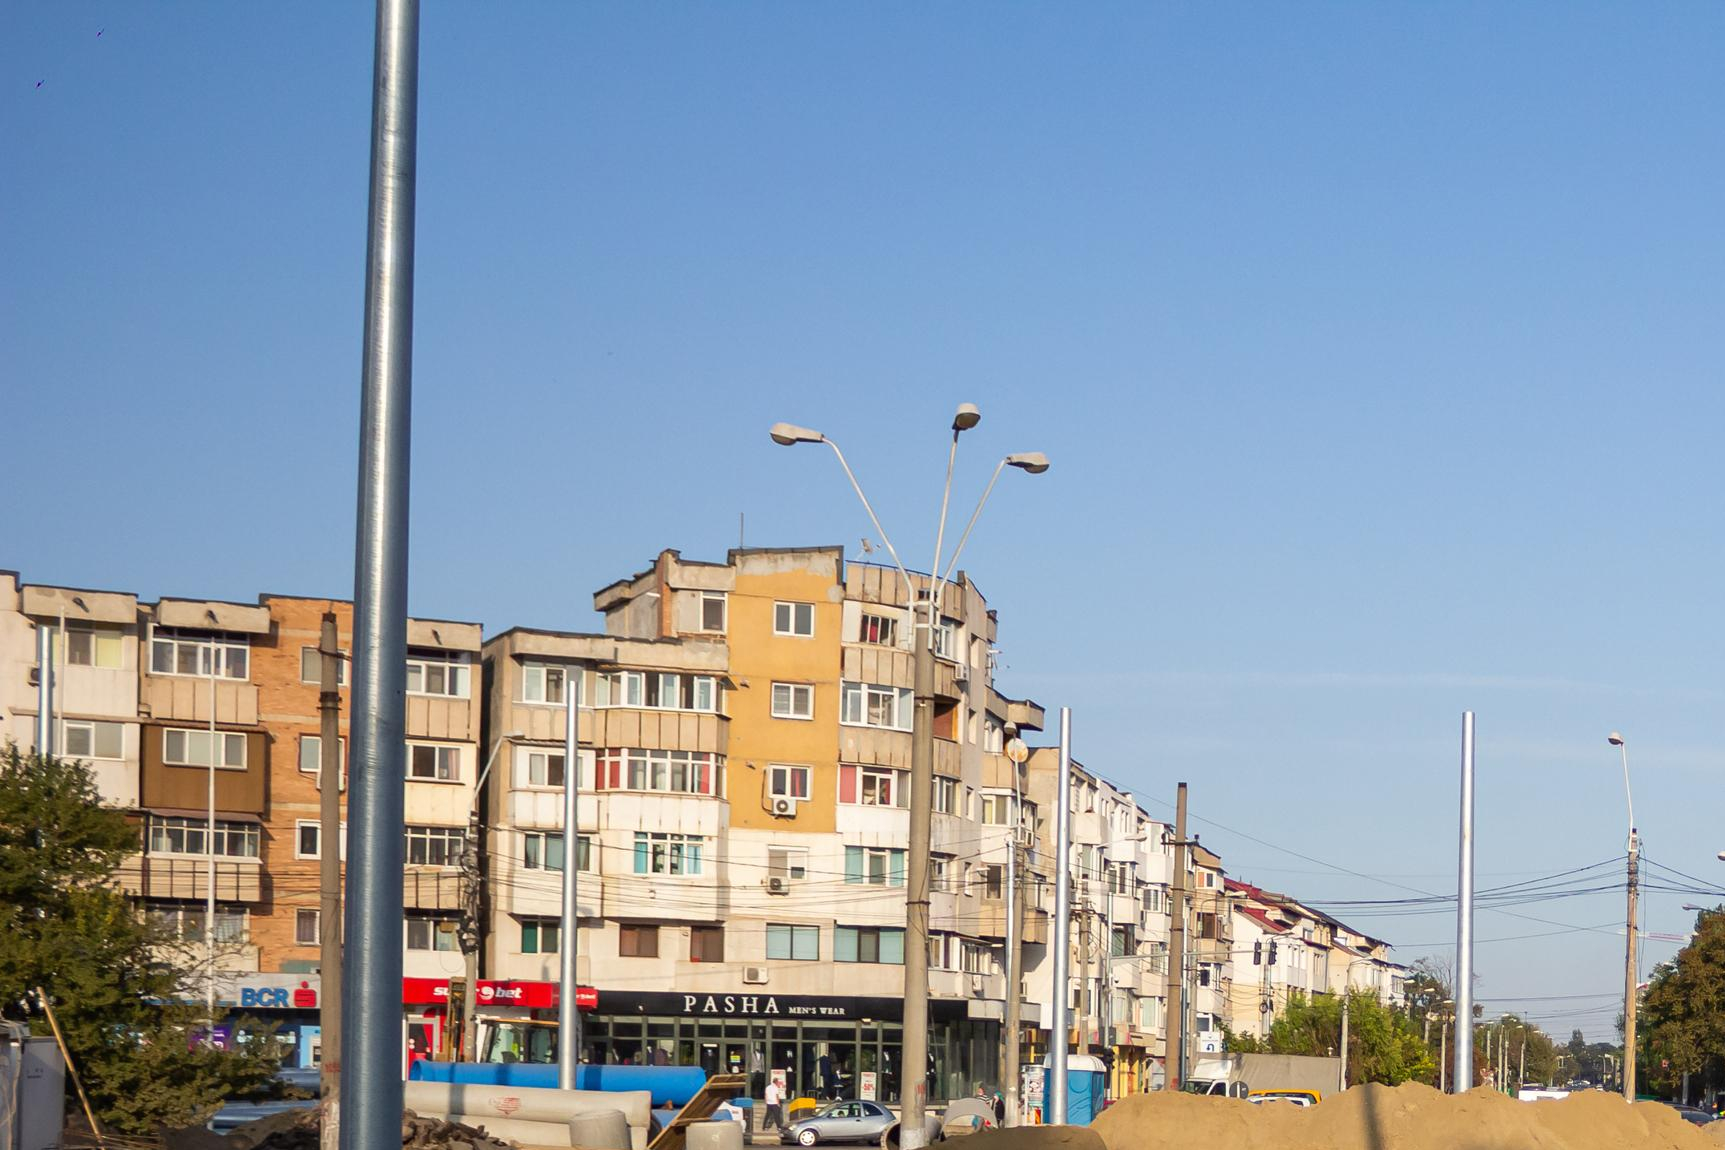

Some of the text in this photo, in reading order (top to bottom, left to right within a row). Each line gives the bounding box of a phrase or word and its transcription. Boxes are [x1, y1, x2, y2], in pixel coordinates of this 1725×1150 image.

[241, 987, 289, 1008] BCR
[683, 995, 780, 1014] PASHA
[820, 1007, 846, 1016] WEAR
